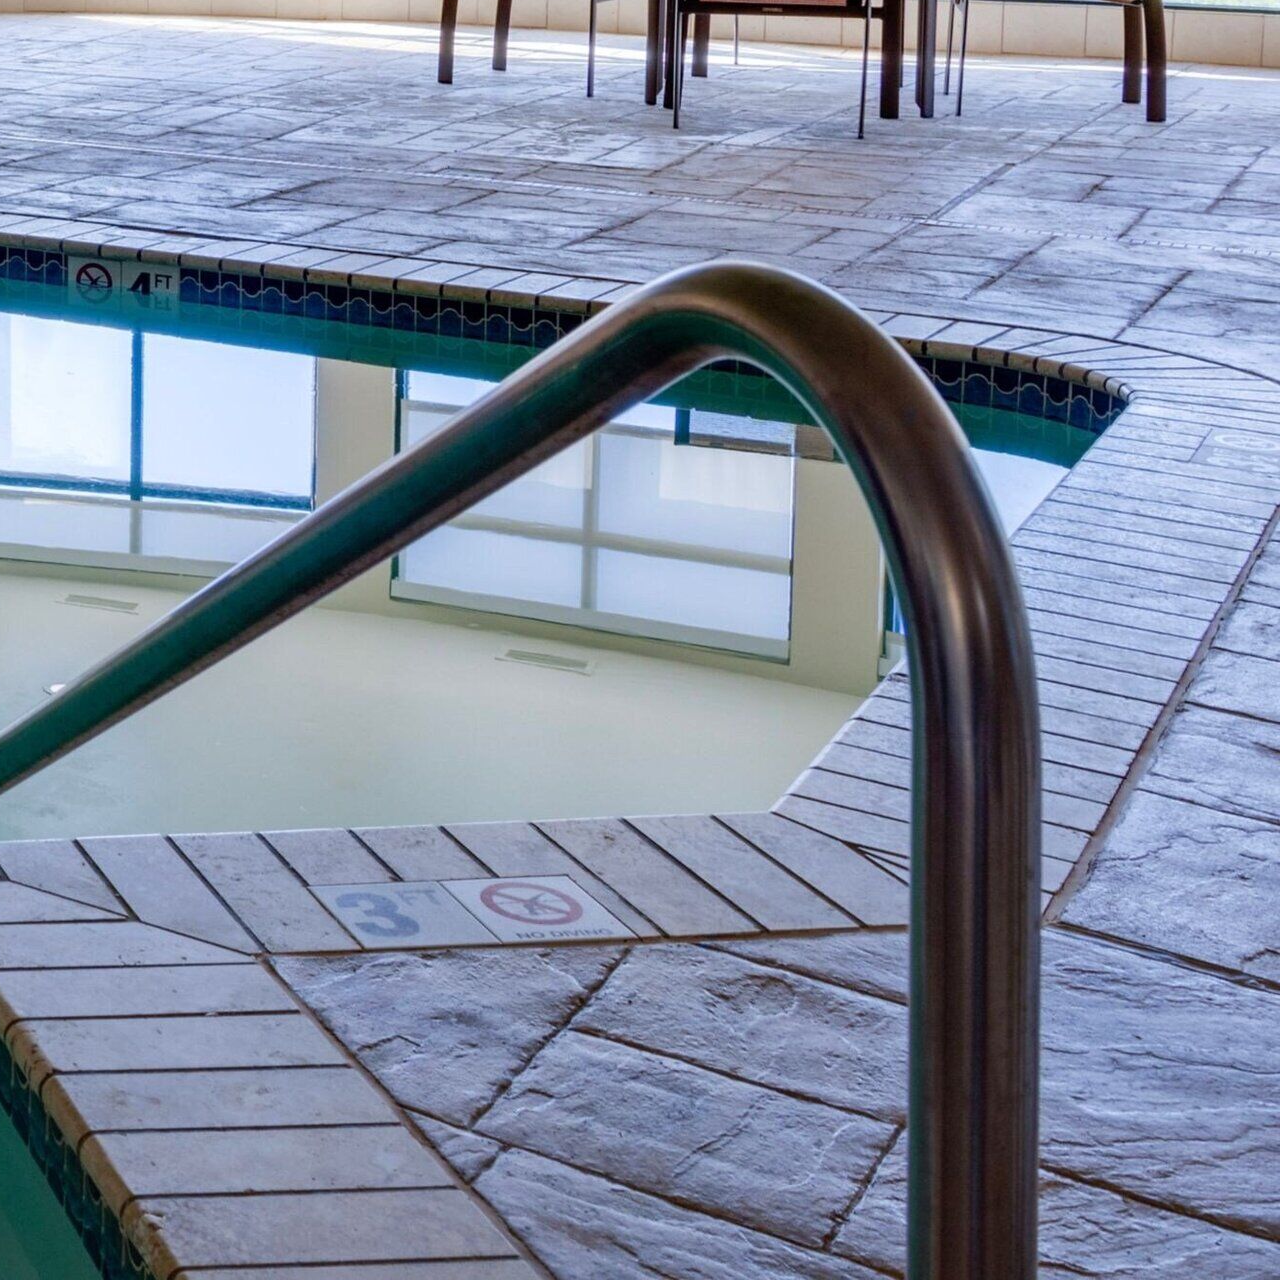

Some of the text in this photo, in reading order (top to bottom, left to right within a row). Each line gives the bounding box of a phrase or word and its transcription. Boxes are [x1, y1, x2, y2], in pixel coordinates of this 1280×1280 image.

[128, 272, 172, 295] 4 FT
[335, 889, 438, 937] 3 FT
[552, 928, 614, 938] DIVING
